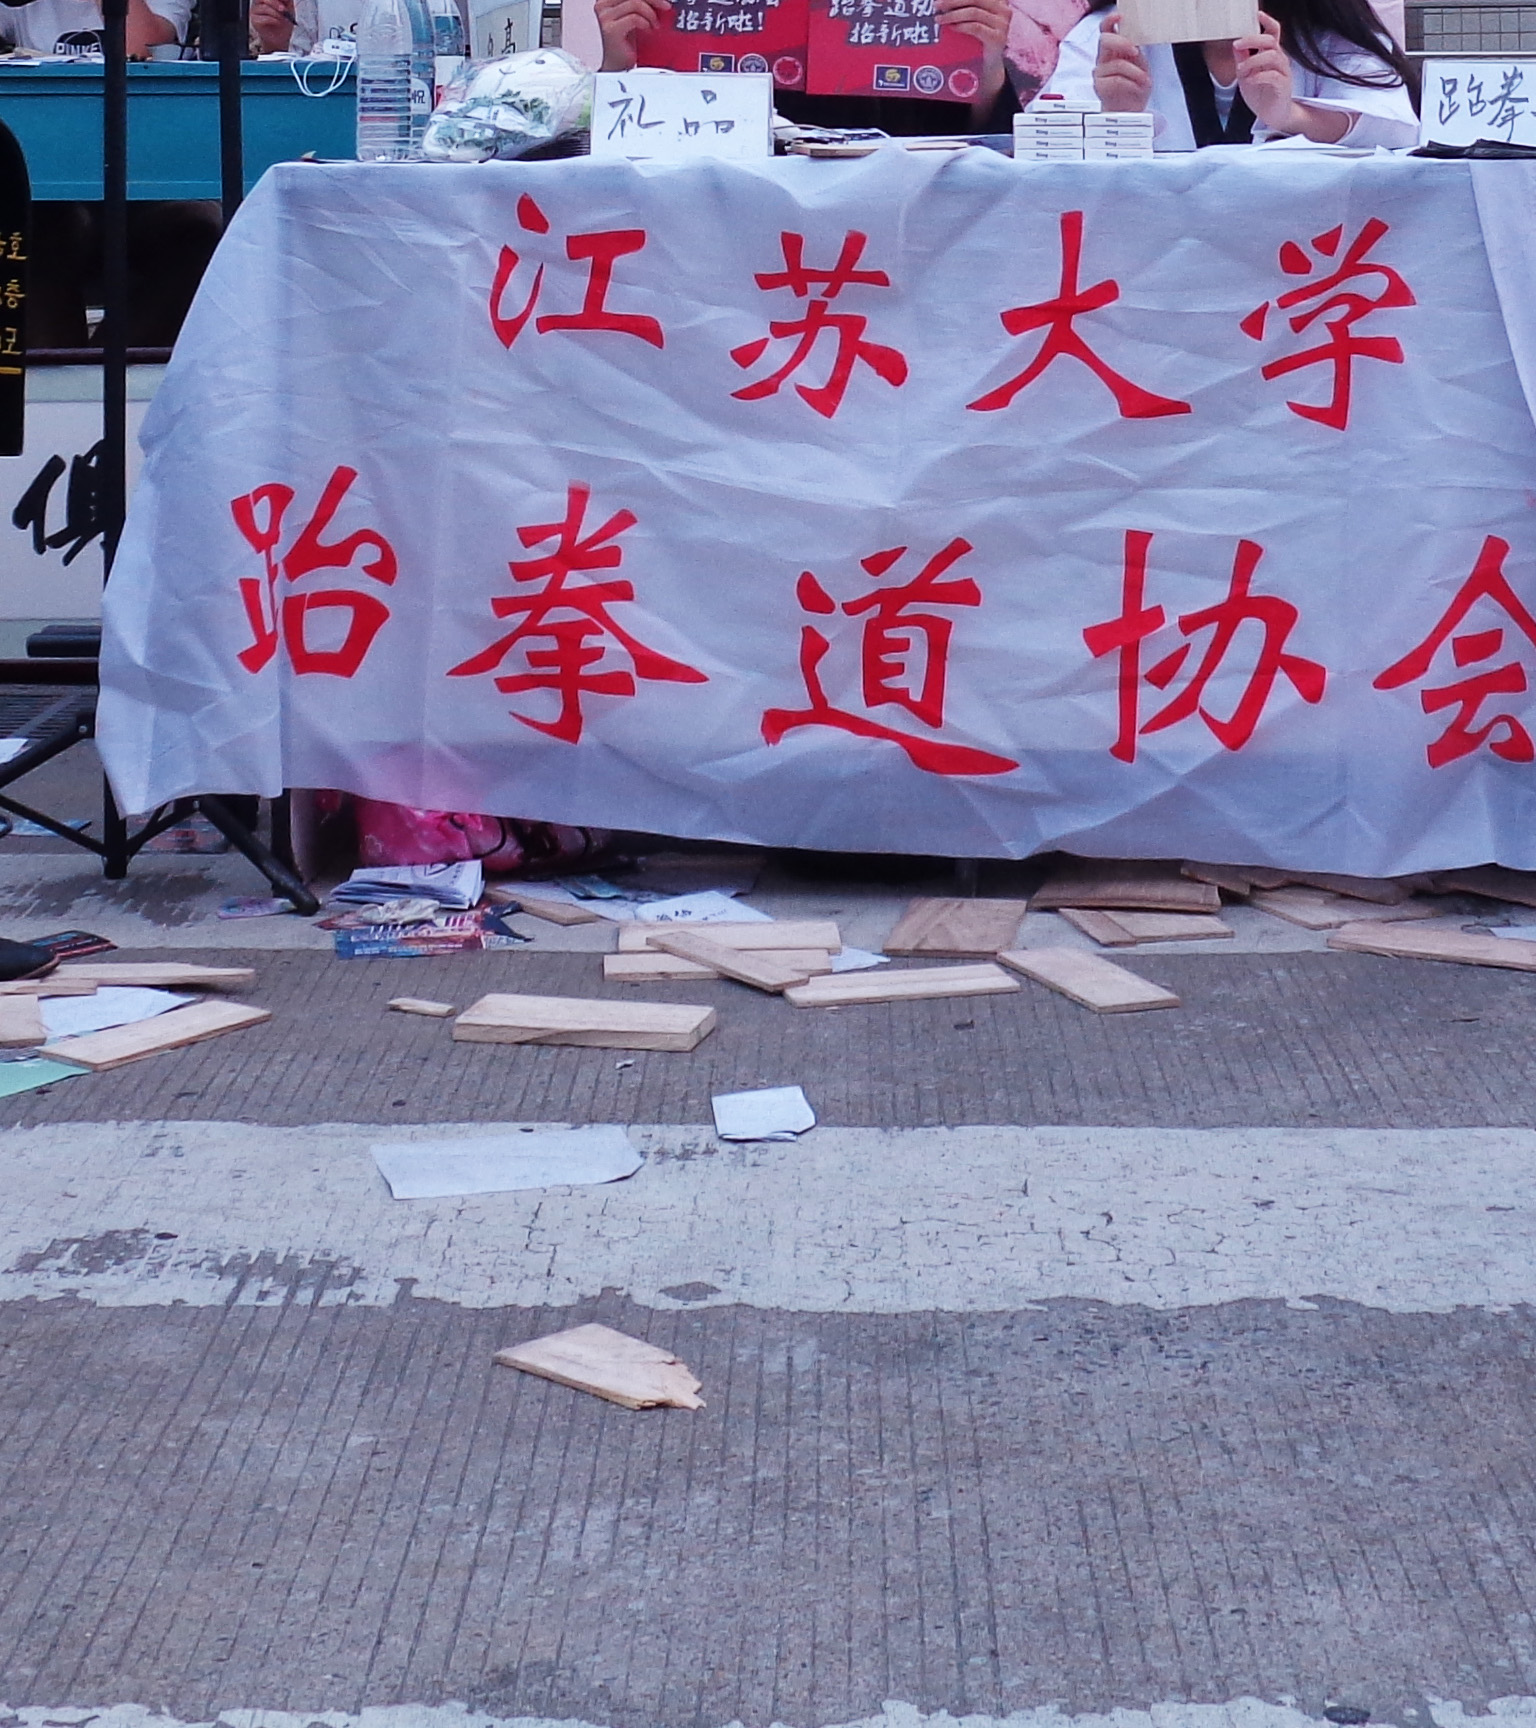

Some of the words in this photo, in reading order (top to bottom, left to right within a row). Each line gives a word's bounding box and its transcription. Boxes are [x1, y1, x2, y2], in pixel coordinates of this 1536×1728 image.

[607, 79, 736, 141] 礼品
[489, 192, 1416, 432] 江苏大学
